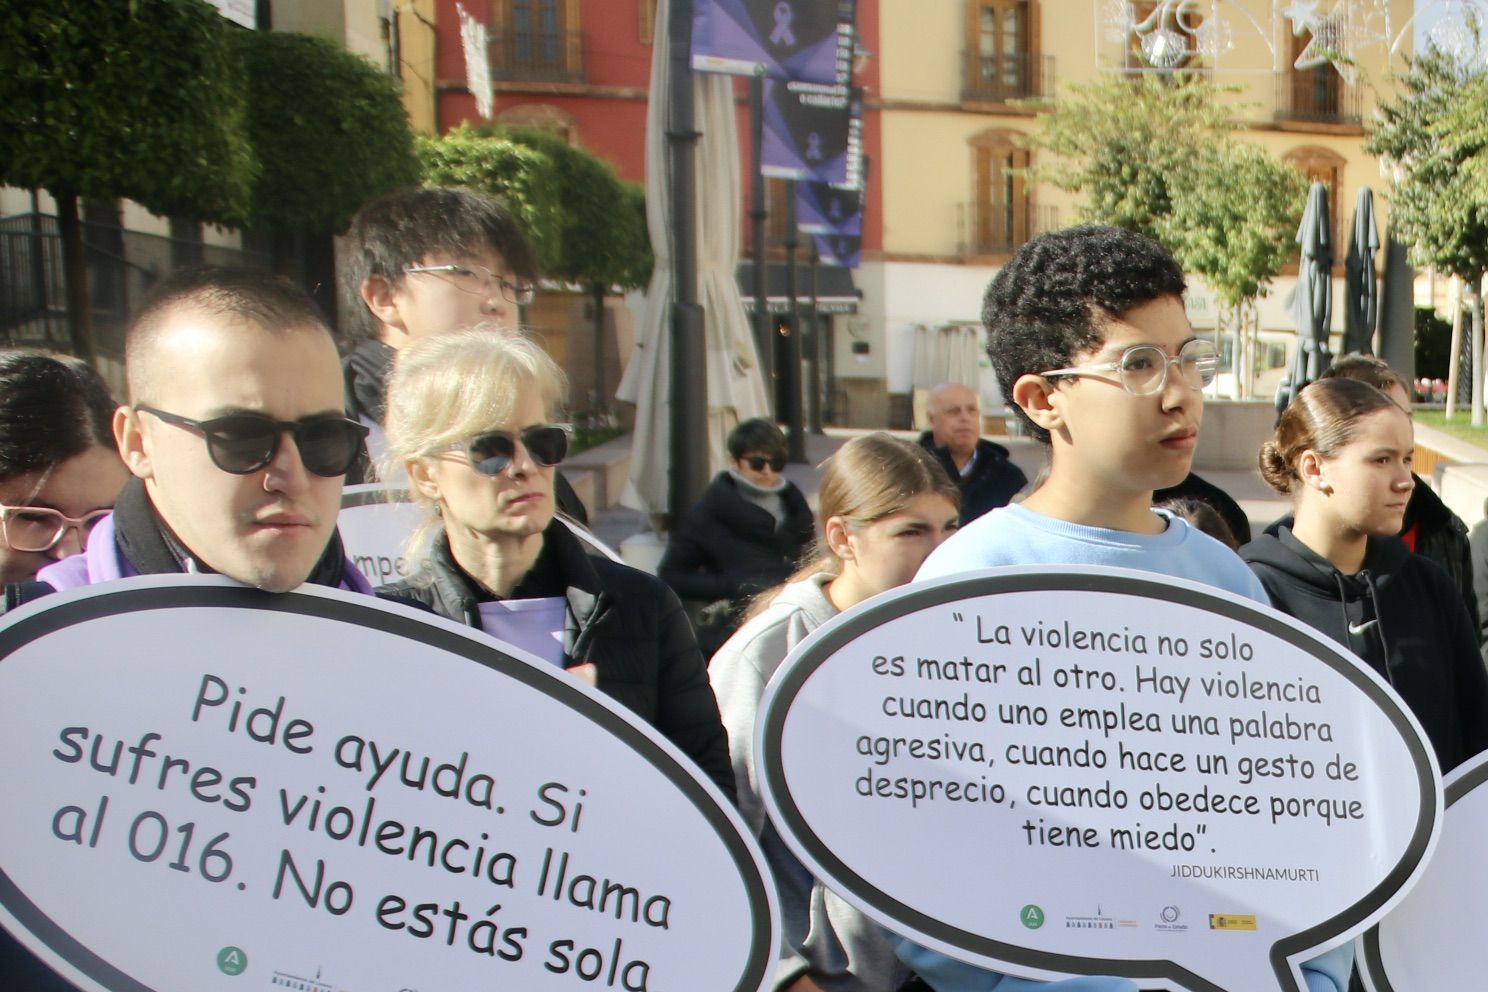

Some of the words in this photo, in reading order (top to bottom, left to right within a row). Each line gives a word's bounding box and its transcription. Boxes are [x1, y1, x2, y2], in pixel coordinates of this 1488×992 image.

[977, 616, 1011, 645] La
[1021, 621, 1147, 654] violencia
[1158, 636, 1188, 656] no
[1200, 633, 1253, 661] solo
[872, 656, 904, 676] es
[917, 656, 1006, 683] matar
[1018, 658, 1040, 686] al
[1054, 664, 1124, 692] otro.
[1136, 665, 1190, 703] Hay
[1201, 672, 1321, 704] violencia
[883, 693, 986, 722] cuando
[999, 704, 1047, 726] uno
[1060, 702, 1161, 738] emplea
[1172, 714, 1219, 736] una
[1230, 711, 1333, 745] palabra
[192, 674, 314, 754] Pide
[334, 735, 504, 814] ayuda.
[530, 782, 586, 832] Si
[855, 733, 994, 767] agresiva,
[1006, 740, 1107, 768] cuando
[1119, 741, 1186, 772] hace
[1197, 754, 1228, 775] un
[1238, 754, 1314, 784] gesto
[1326, 753, 1358, 781] de
[855, 769, 1015, 809] desprecio,
[1027, 780, 1127, 809] cuando
[1140, 783, 1260, 815] obedece
[1270, 796, 1364, 826] porque
[53, 727, 256, 812] sufres
[280, 786, 517, 889] violencia
[537, 848, 671, 930] llama
[1022, 819, 1100, 847] tiene
[52, 796, 109, 848] al
[129, 811, 246, 890] 016.
[272, 849, 353, 915] No
[376, 895, 528, 962] estás
[1171, 865, 1319, 881] JIDDUKIRSHNAMURTI
